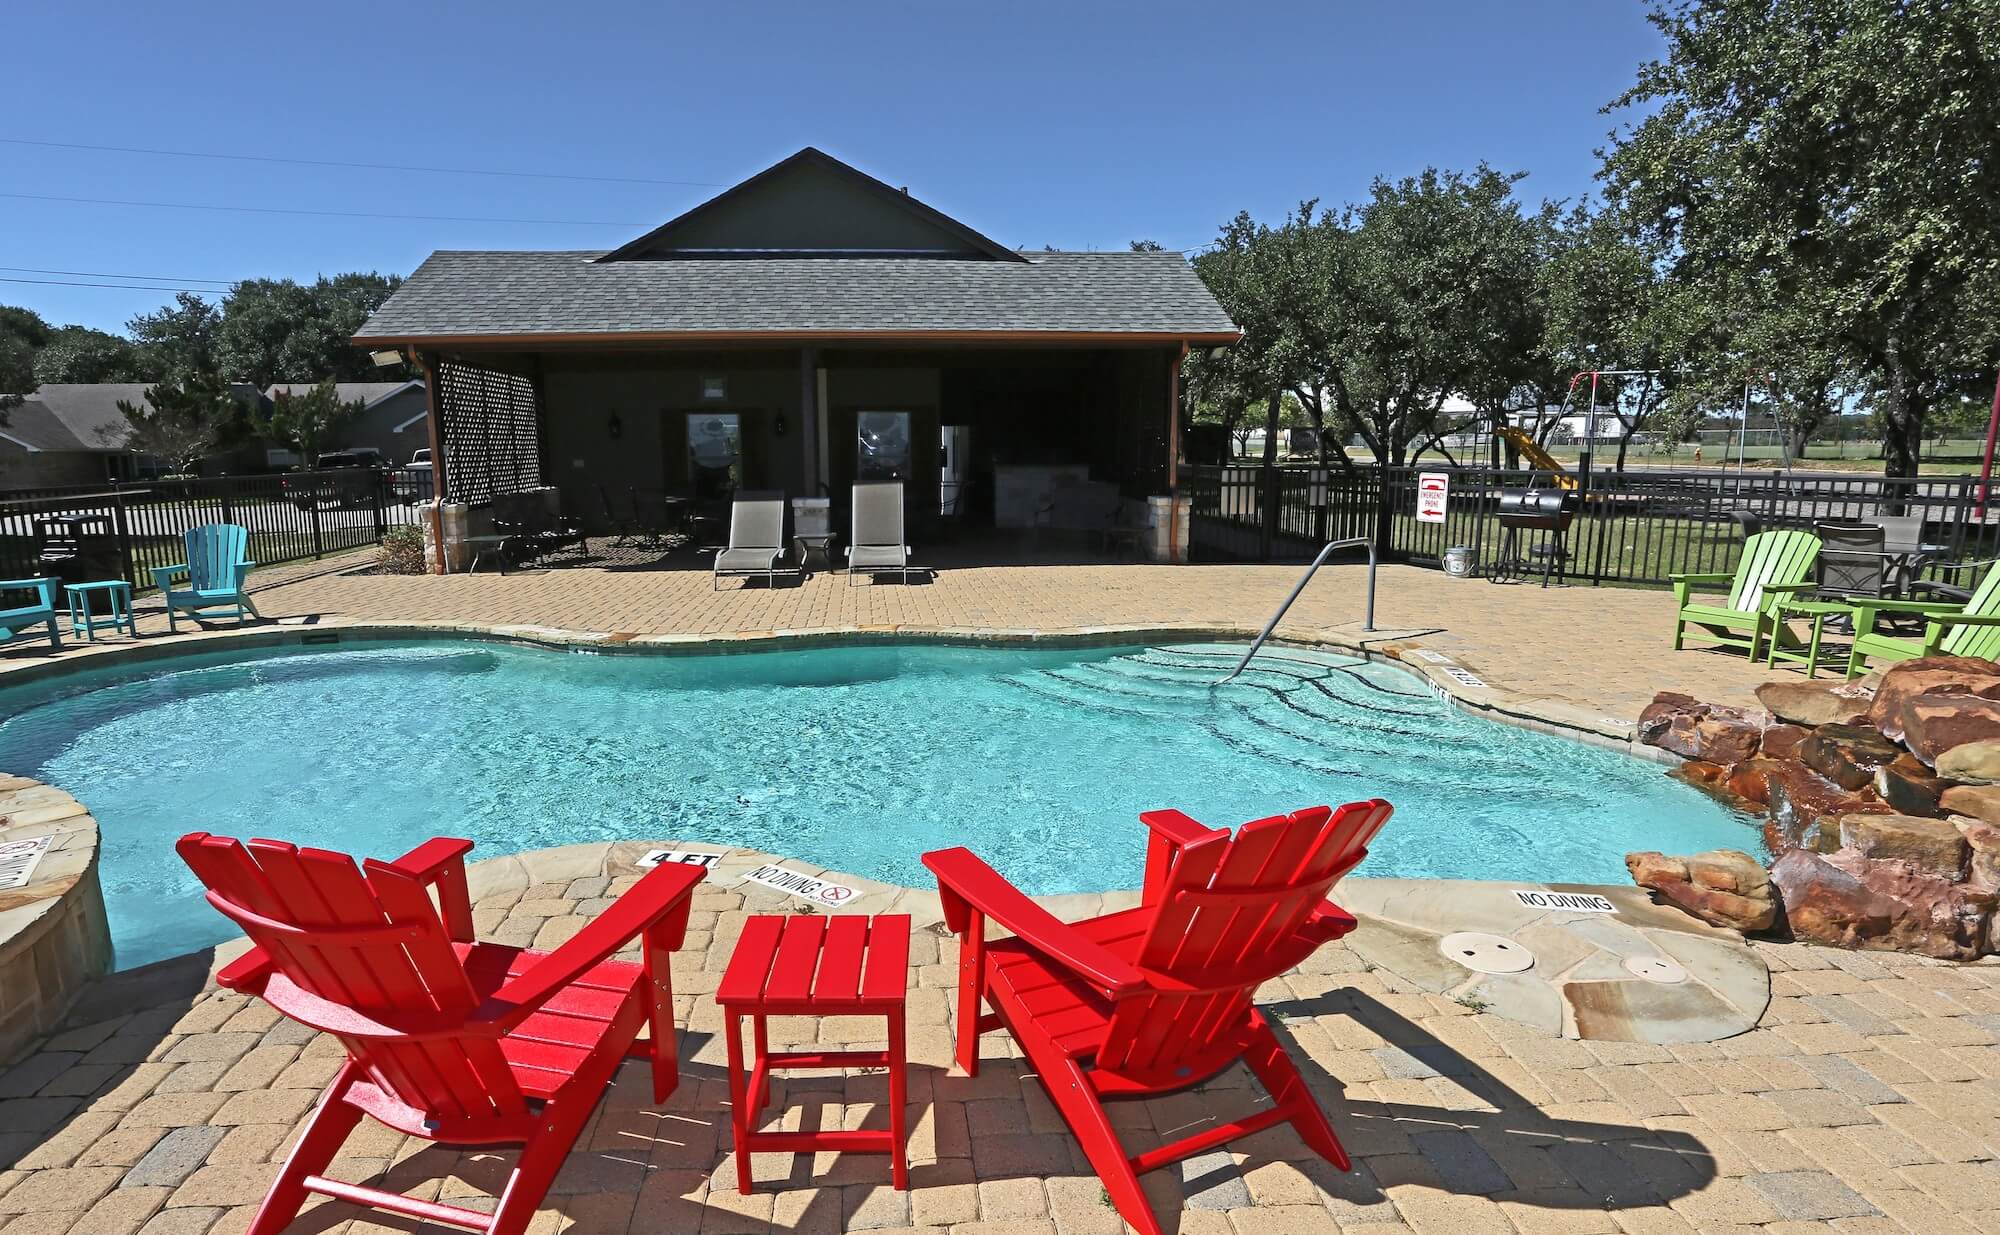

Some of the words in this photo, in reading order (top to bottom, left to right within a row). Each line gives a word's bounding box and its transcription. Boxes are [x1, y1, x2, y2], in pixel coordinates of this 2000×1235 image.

[1420, 491, 1445, 500] EMERGENCY
[651, 853, 672, 864] 4
[680, 854, 719, 866] FT
[747, 866, 778, 880] NO
[768, 872, 822, 894] DIVING
[1516, 892, 1547, 906] NO
[1547, 894, 1613, 910] DIVING
